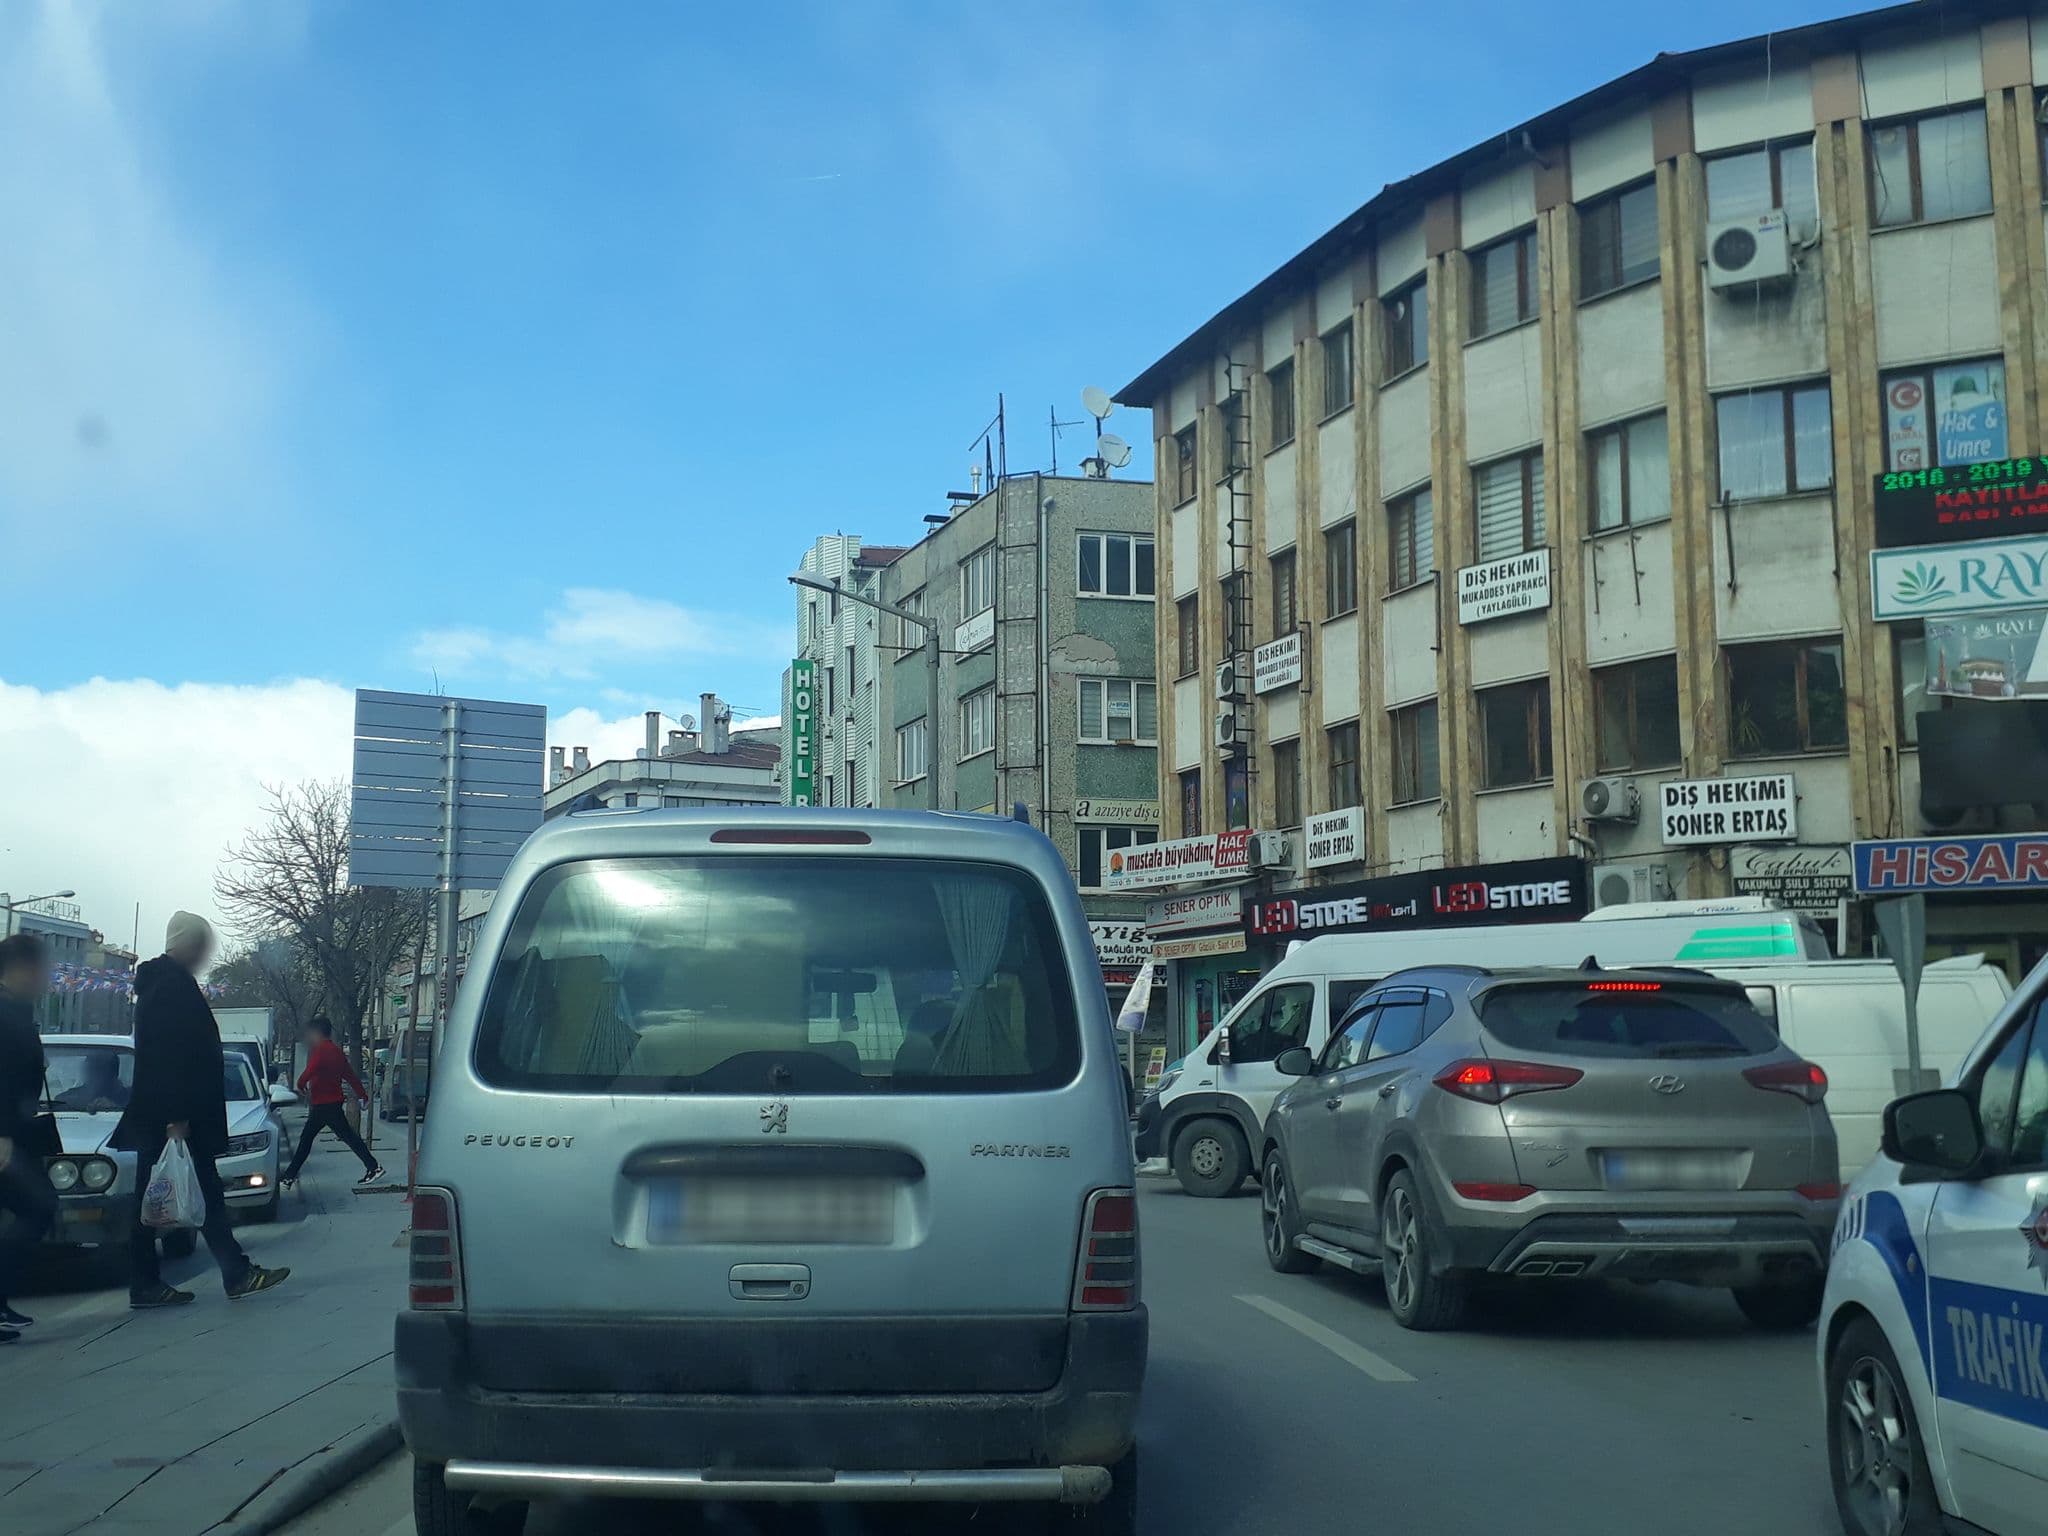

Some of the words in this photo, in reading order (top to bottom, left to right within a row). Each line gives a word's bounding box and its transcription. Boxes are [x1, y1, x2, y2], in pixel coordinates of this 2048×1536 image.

[1943, 411, 1976, 433] Hac
[1946, 438, 1991, 459] Umre
[1968, 457, 2032, 481] 2019
[1461, 585, 1505, 605] MUKADDES
[796, 669, 811, 779] HOTEL
[1667, 812, 1725, 837] SONER
[1732, 808, 1787, 835] ERTAŞ
[1219, 834, 1244, 849] HAC
[1309, 840, 1331, 860] SONER
[1333, 835, 1354, 856] ERTAŞ
[1127, 848, 1162, 871] mustafa
[1165, 842, 1215, 869] büyükdinç
[1738, 879, 1780, 890] VAKUMLU
[1785, 878, 1809, 889] SULU
[1164, 899, 1195, 920] ŞENER
[1199, 891, 1232, 910] OPTİK
[1432, 882, 1488, 913] LED
[1490, 880, 1571, 909] STORE
[1252, 899, 1298, 934] LED
[1300, 896, 1368, 930] STORE
[464, 1134, 574, 1148] PEUGEOT
[970, 1144, 1071, 1158] PARTNER
